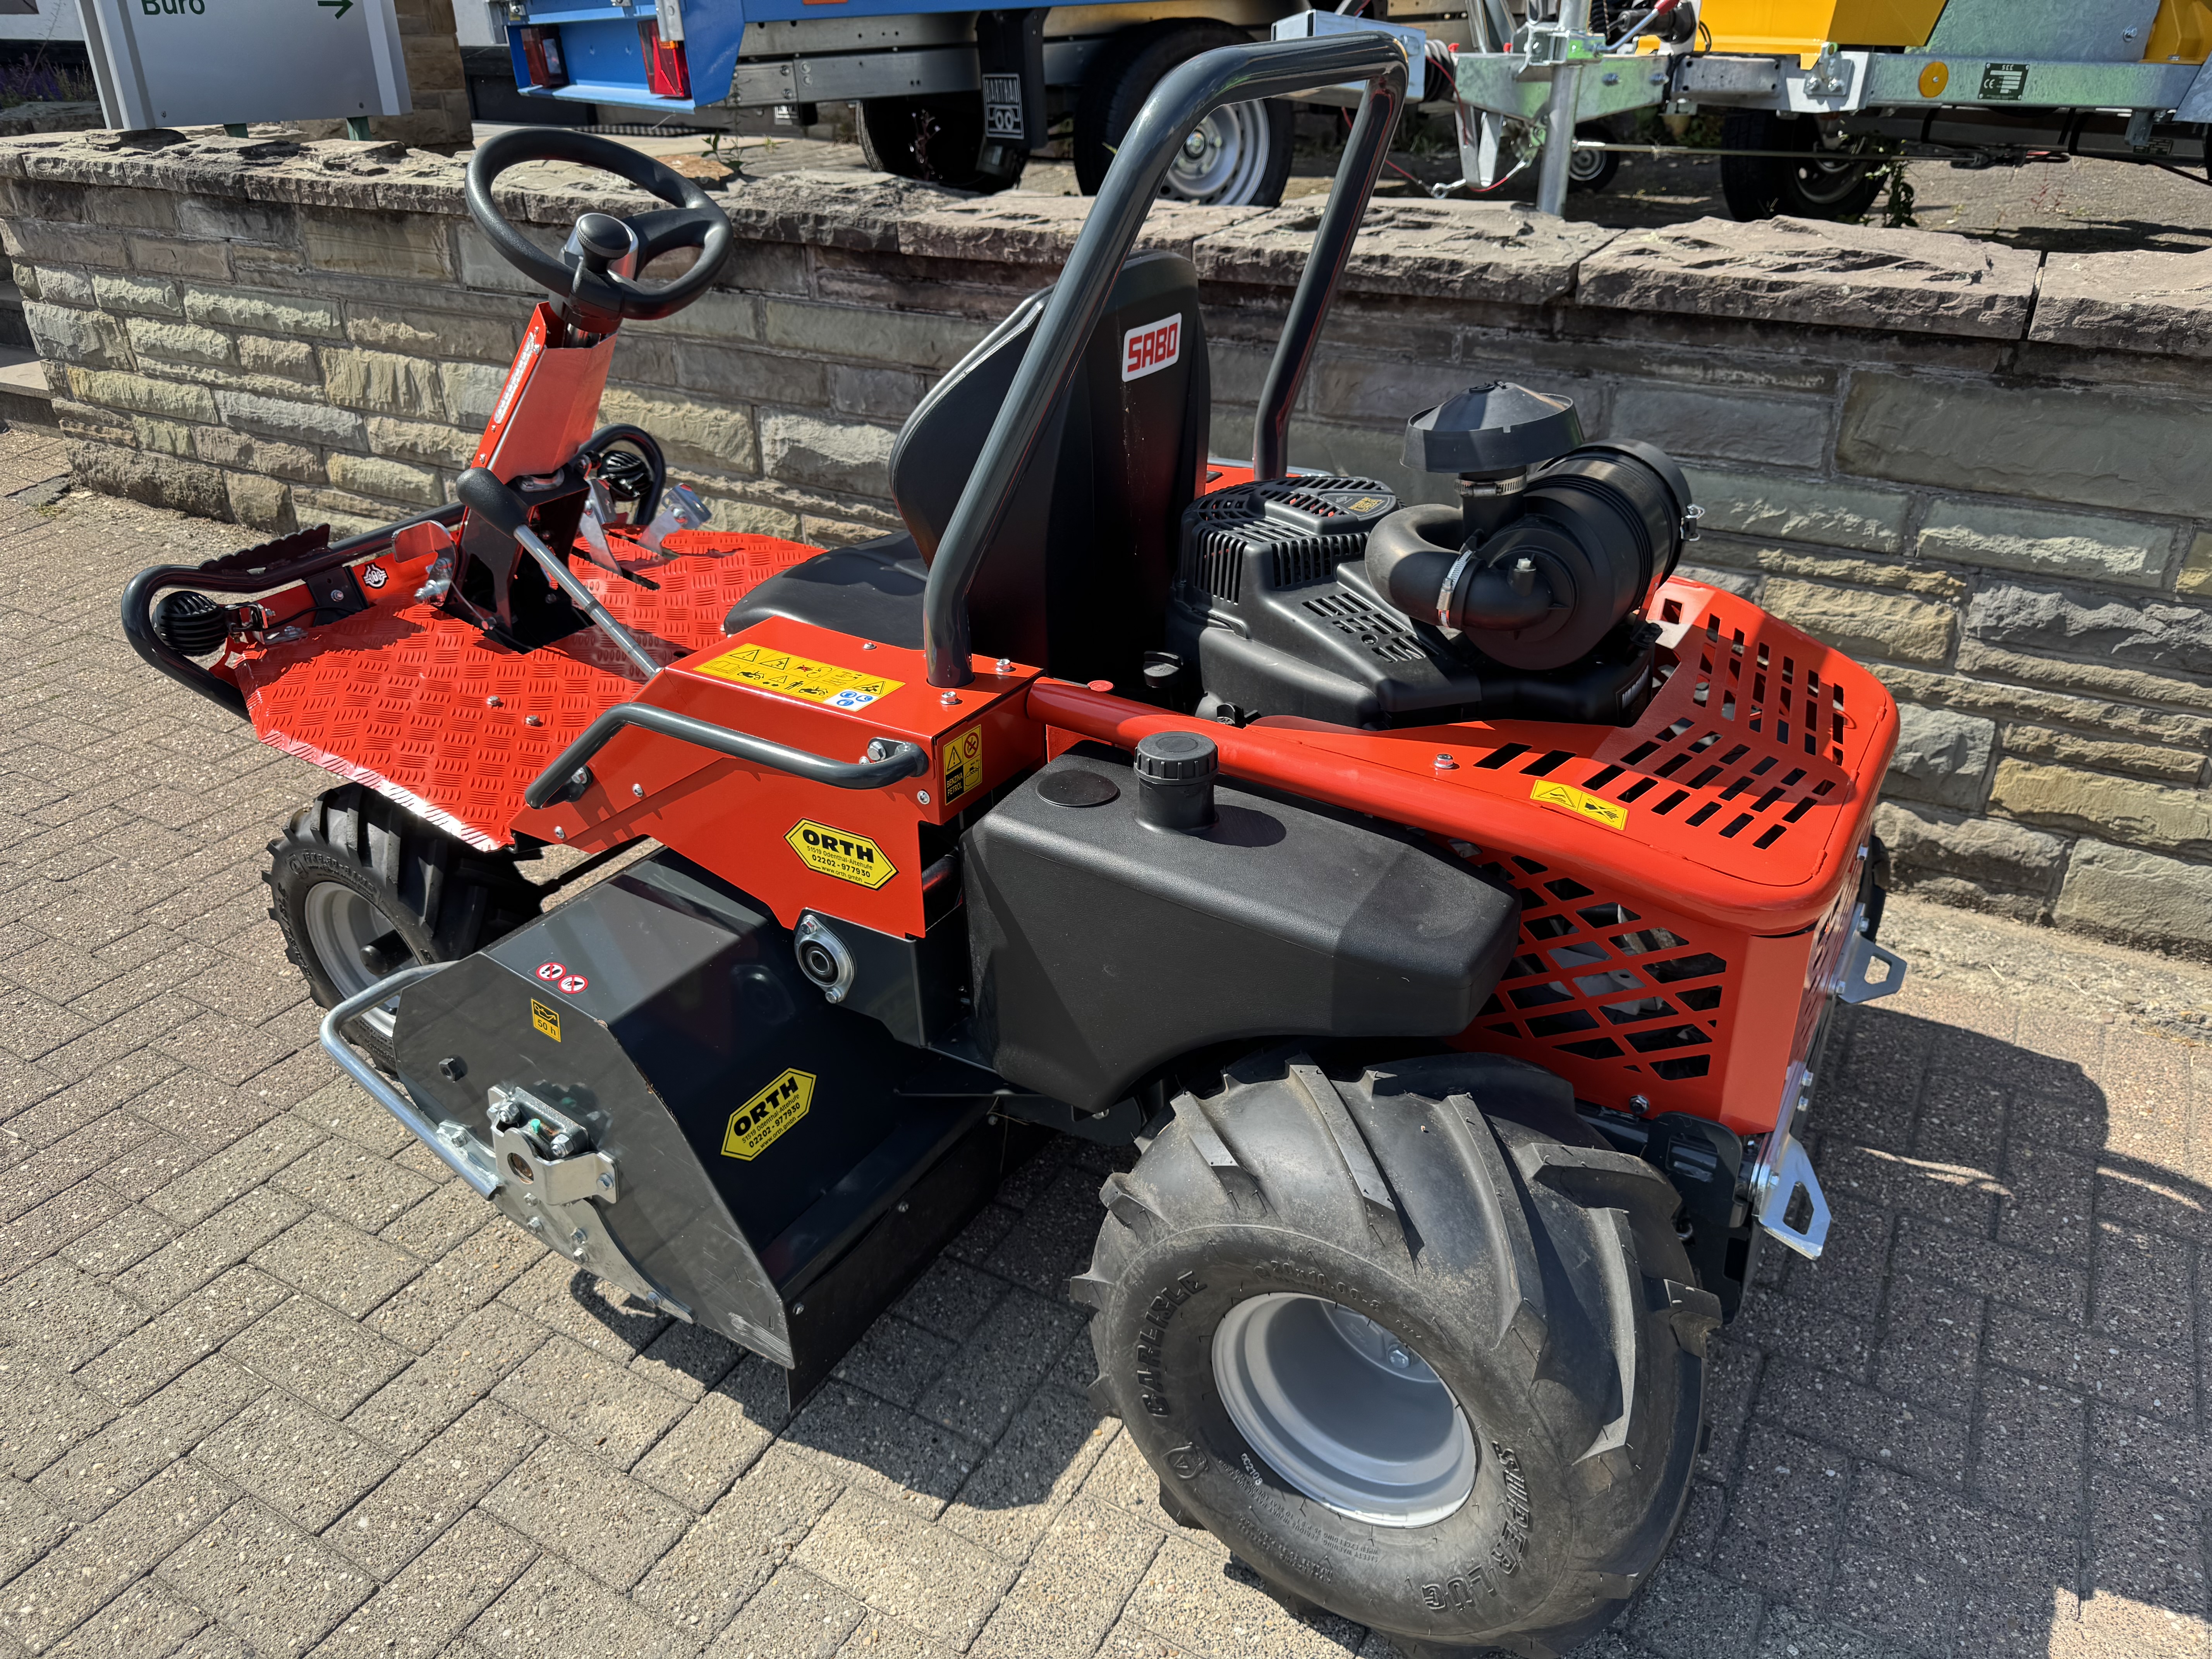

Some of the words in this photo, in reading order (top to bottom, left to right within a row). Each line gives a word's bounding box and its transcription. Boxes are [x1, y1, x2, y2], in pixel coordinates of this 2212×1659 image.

[1127, 323, 1178, 373] SABO
[947, 772, 963, 788] BENZINA
[948, 782, 962, 796] PETROL
[803, 830, 874, 863] ORTH
[807, 846, 822, 854] 51519
[823, 851, 872, 870] Odenthal-Altehufe
[812, 854, 836, 867] 02202
[842, 864, 870, 878] 977930
[821, 866, 862, 882] www.orth.gmbh
[538, 1019, 548, 1030] 50
[551, 1026, 556, 1036] h
[734, 1076, 799, 1136] ORTH
[742, 1129, 756, 1143] 51519
[757, 1094, 799, 1131] Odenthal-Altehufe
[749, 1127, 771, 1148] 02202
[775, 1103, 800, 1127] 977930
[760, 1116, 796, 1148] www.orth.gmbh
[1271, 1260, 1380, 1311] 20x10.00-8
[1137, 1271, 1207, 1417] CARLISLE
[1491, 1440, 1530, 1575] SUPER
[1354, 1551, 1378, 1563] SAFETY
[1422, 1564, 1494, 1610] LUG
